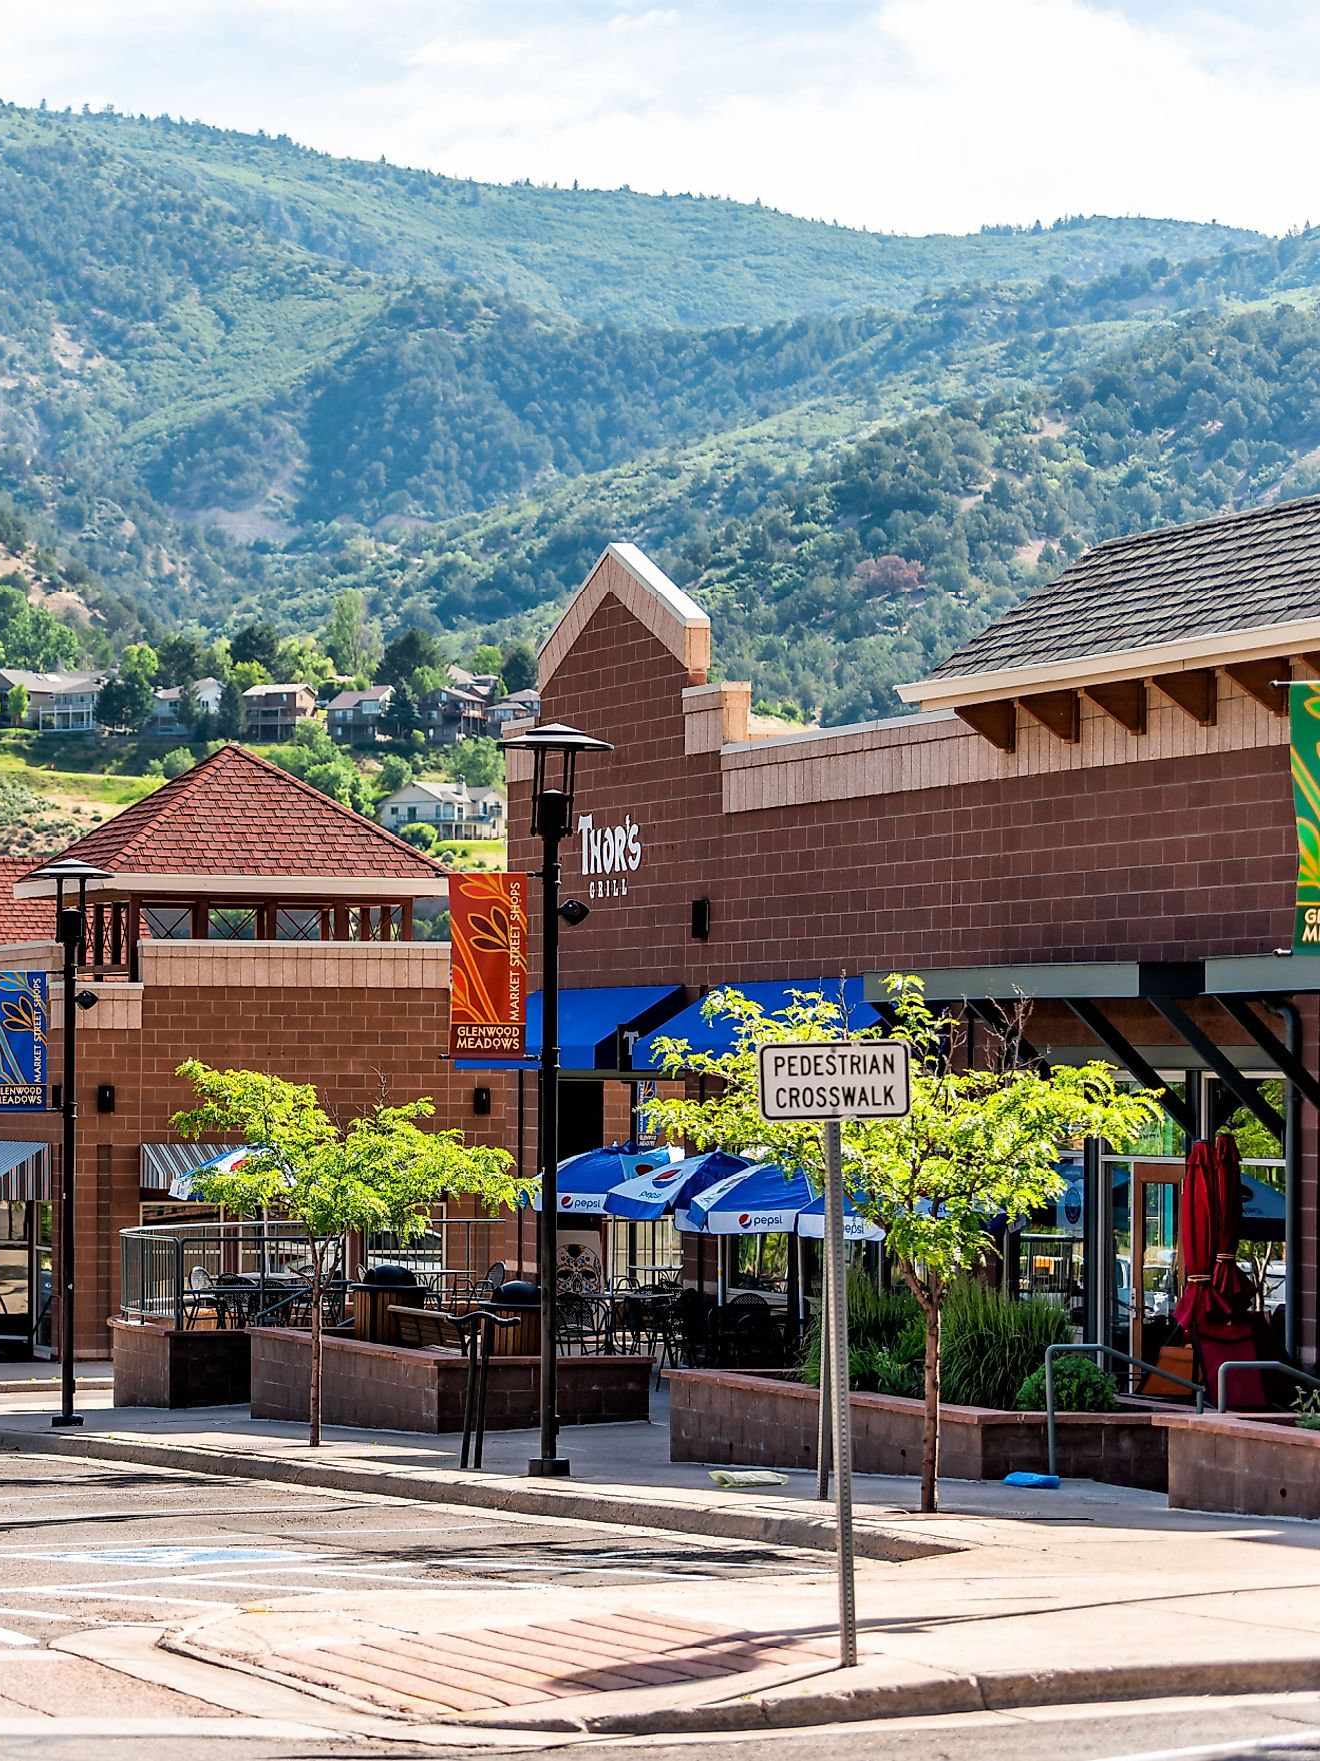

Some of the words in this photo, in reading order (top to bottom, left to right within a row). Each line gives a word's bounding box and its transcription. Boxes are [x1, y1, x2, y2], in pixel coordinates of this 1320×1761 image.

[589, 878, 628, 899] GRILL
[509, 882, 522, 921] SHOPS
[509, 925, 521, 966] STREET
[32, 977, 42, 1007] SHOPS
[509, 971, 521, 1021] MARKET
[33, 1010, 42, 1042] STREET
[457, 1026, 520, 1038] GLENWOOD
[456, 1037, 520, 1049] MEADOWS
[33, 1045, 42, 1083] MARKET
[774, 1053, 895, 1077] PEDESTRIAN
[776, 1085, 895, 1109] CROSSWALK
[574, 1199, 601, 1209] pepsi
[753, 1214, 783, 1227] pepsi
[842, 1217, 865, 1236] epsi
